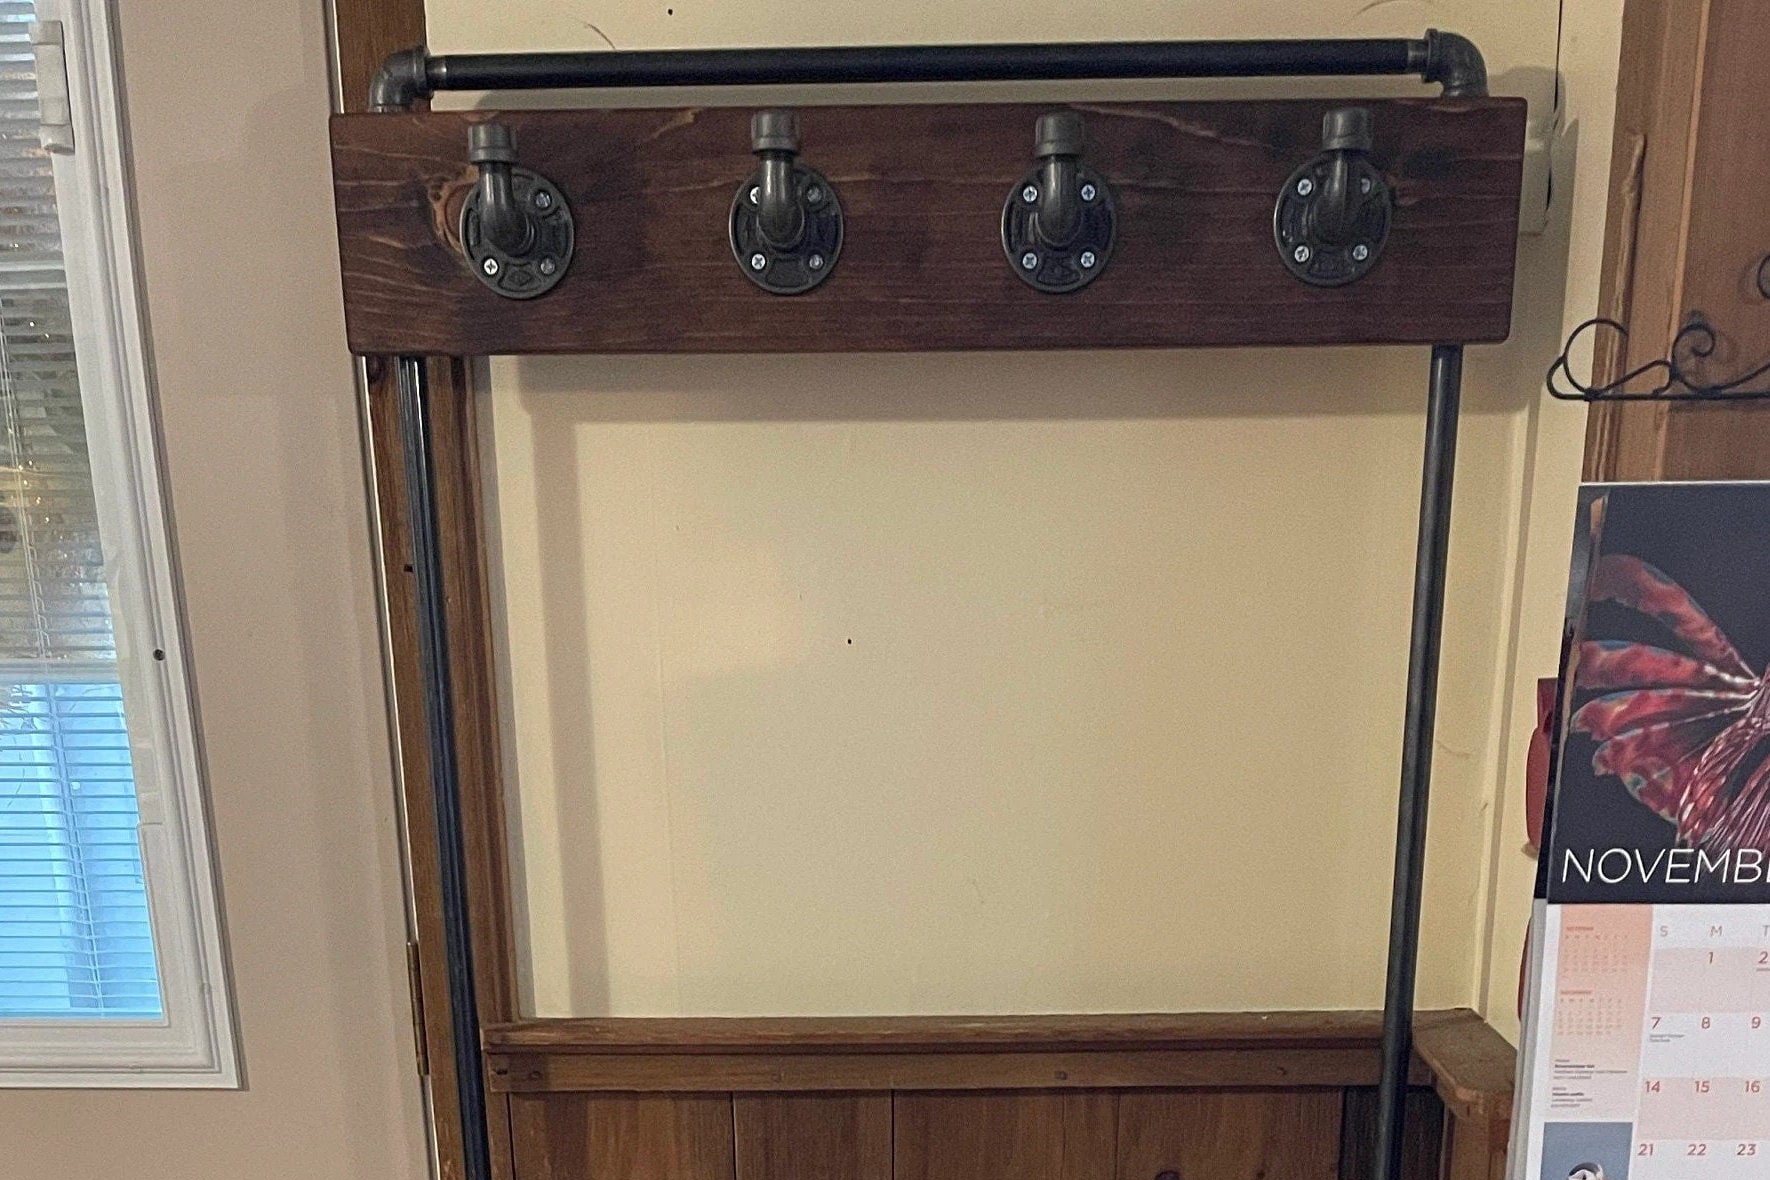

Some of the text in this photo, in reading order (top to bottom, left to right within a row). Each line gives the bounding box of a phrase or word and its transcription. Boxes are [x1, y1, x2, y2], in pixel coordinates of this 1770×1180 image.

[1562, 848, 1770, 883] NOVEMB
[1659, 926, 1668, 937] S
[1710, 926, 1723, 937] M
[1708, 951, 1768, 964] 1 2
[1651, 1016, 1761, 1030] 7 8 9
[1645, 1081, 1761, 1093] 14 15 16
[1638, 1143, 1757, 1156] 21 22 23
